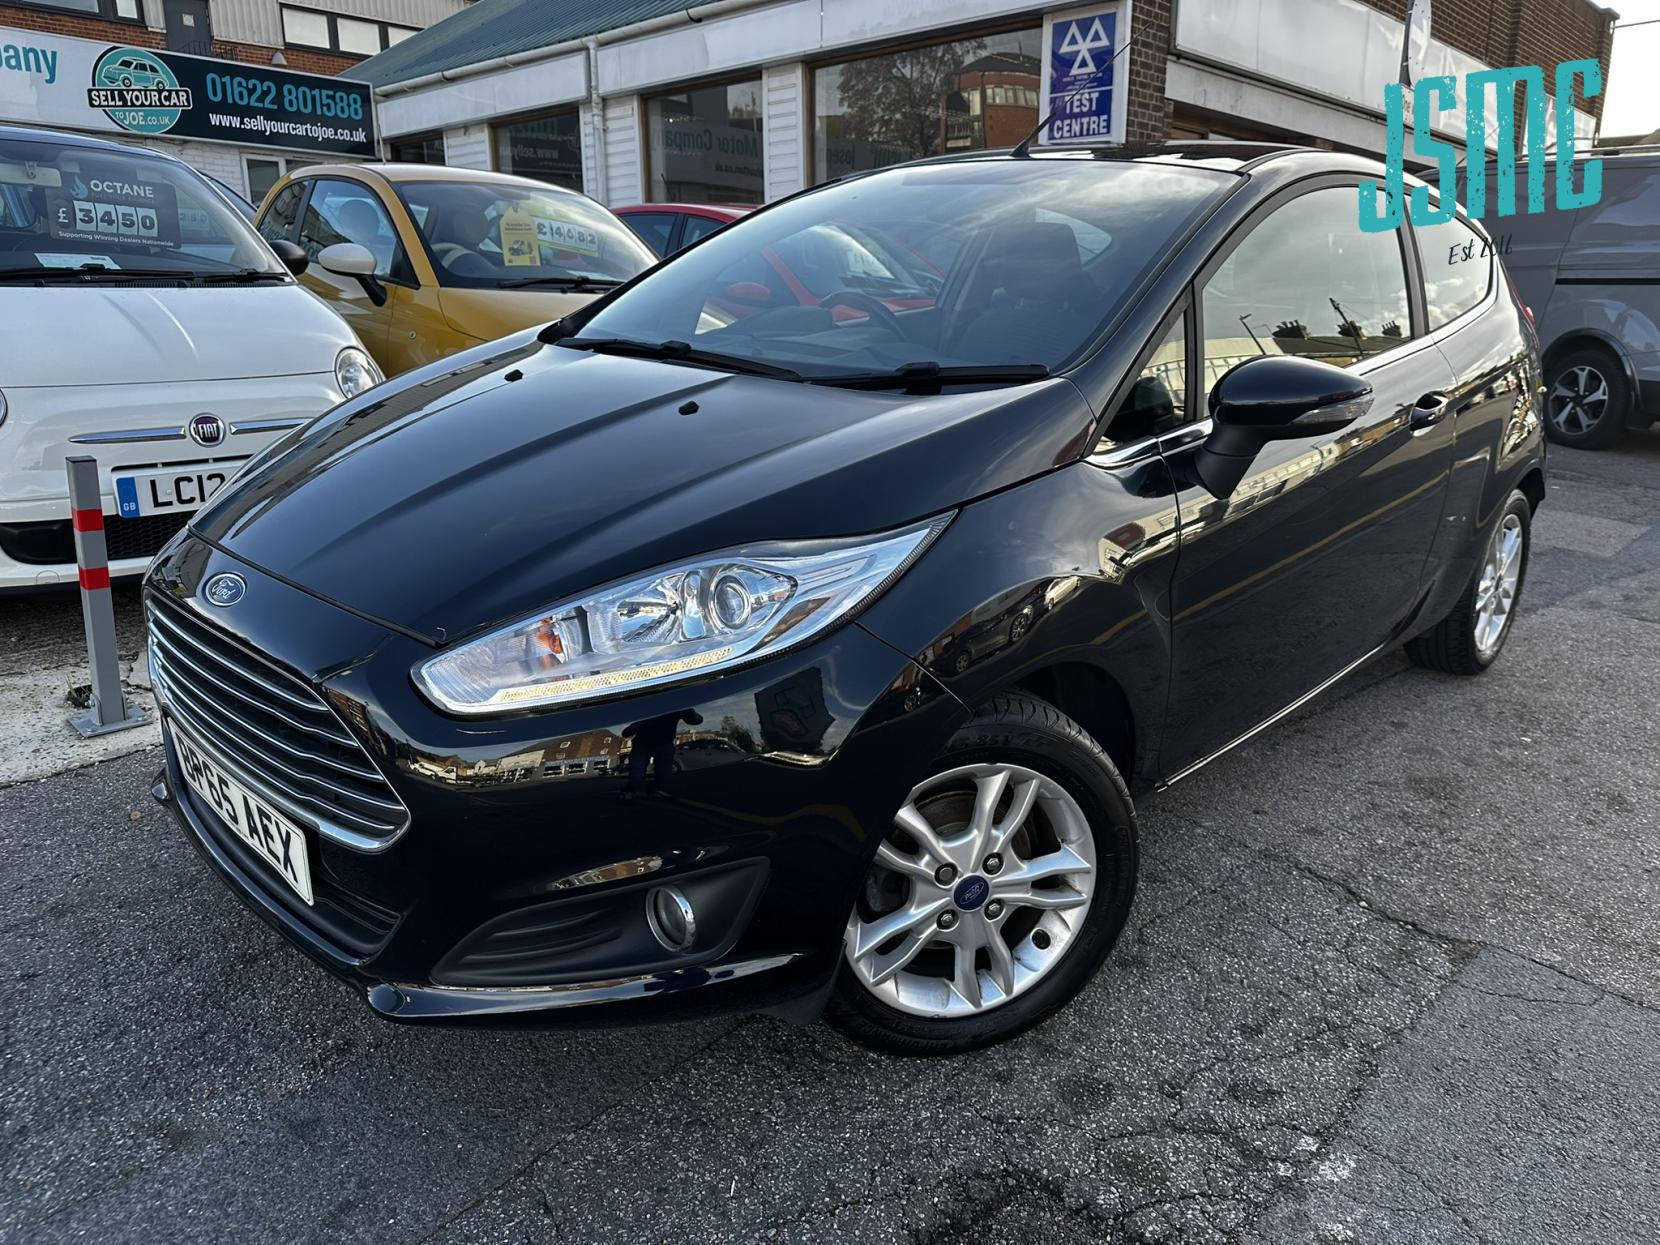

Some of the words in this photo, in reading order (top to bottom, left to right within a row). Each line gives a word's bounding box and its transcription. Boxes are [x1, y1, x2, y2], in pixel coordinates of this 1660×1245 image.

[91, 90, 122, 106] SELL
[123, 91, 159, 107] YOUR
[161, 91, 188, 107] CAR
[206, 72, 278, 110] 01622
[282, 84, 363, 121] 801588
[1064, 91, 1100, 114] TEST
[115, 111, 124, 119] TO
[208, 113, 367, 143] www.sellyourcartojoe.co.uk
[1053, 114, 1109, 139] CENTRE
[89, 179, 155, 198] OCTANE
[58, 231, 93, 240] Supporting
[93, 233, 119, 242] Winning
[119, 236, 141, 244] Dealers
[142, 238, 174, 247] Nationwide
[198, 423, 218, 438] FIAT
[123, 502, 136, 511] GB
[212, 579, 238, 599] Ford
[175, 731, 239, 826] BP65
[242, 794, 299, 884] AEX
